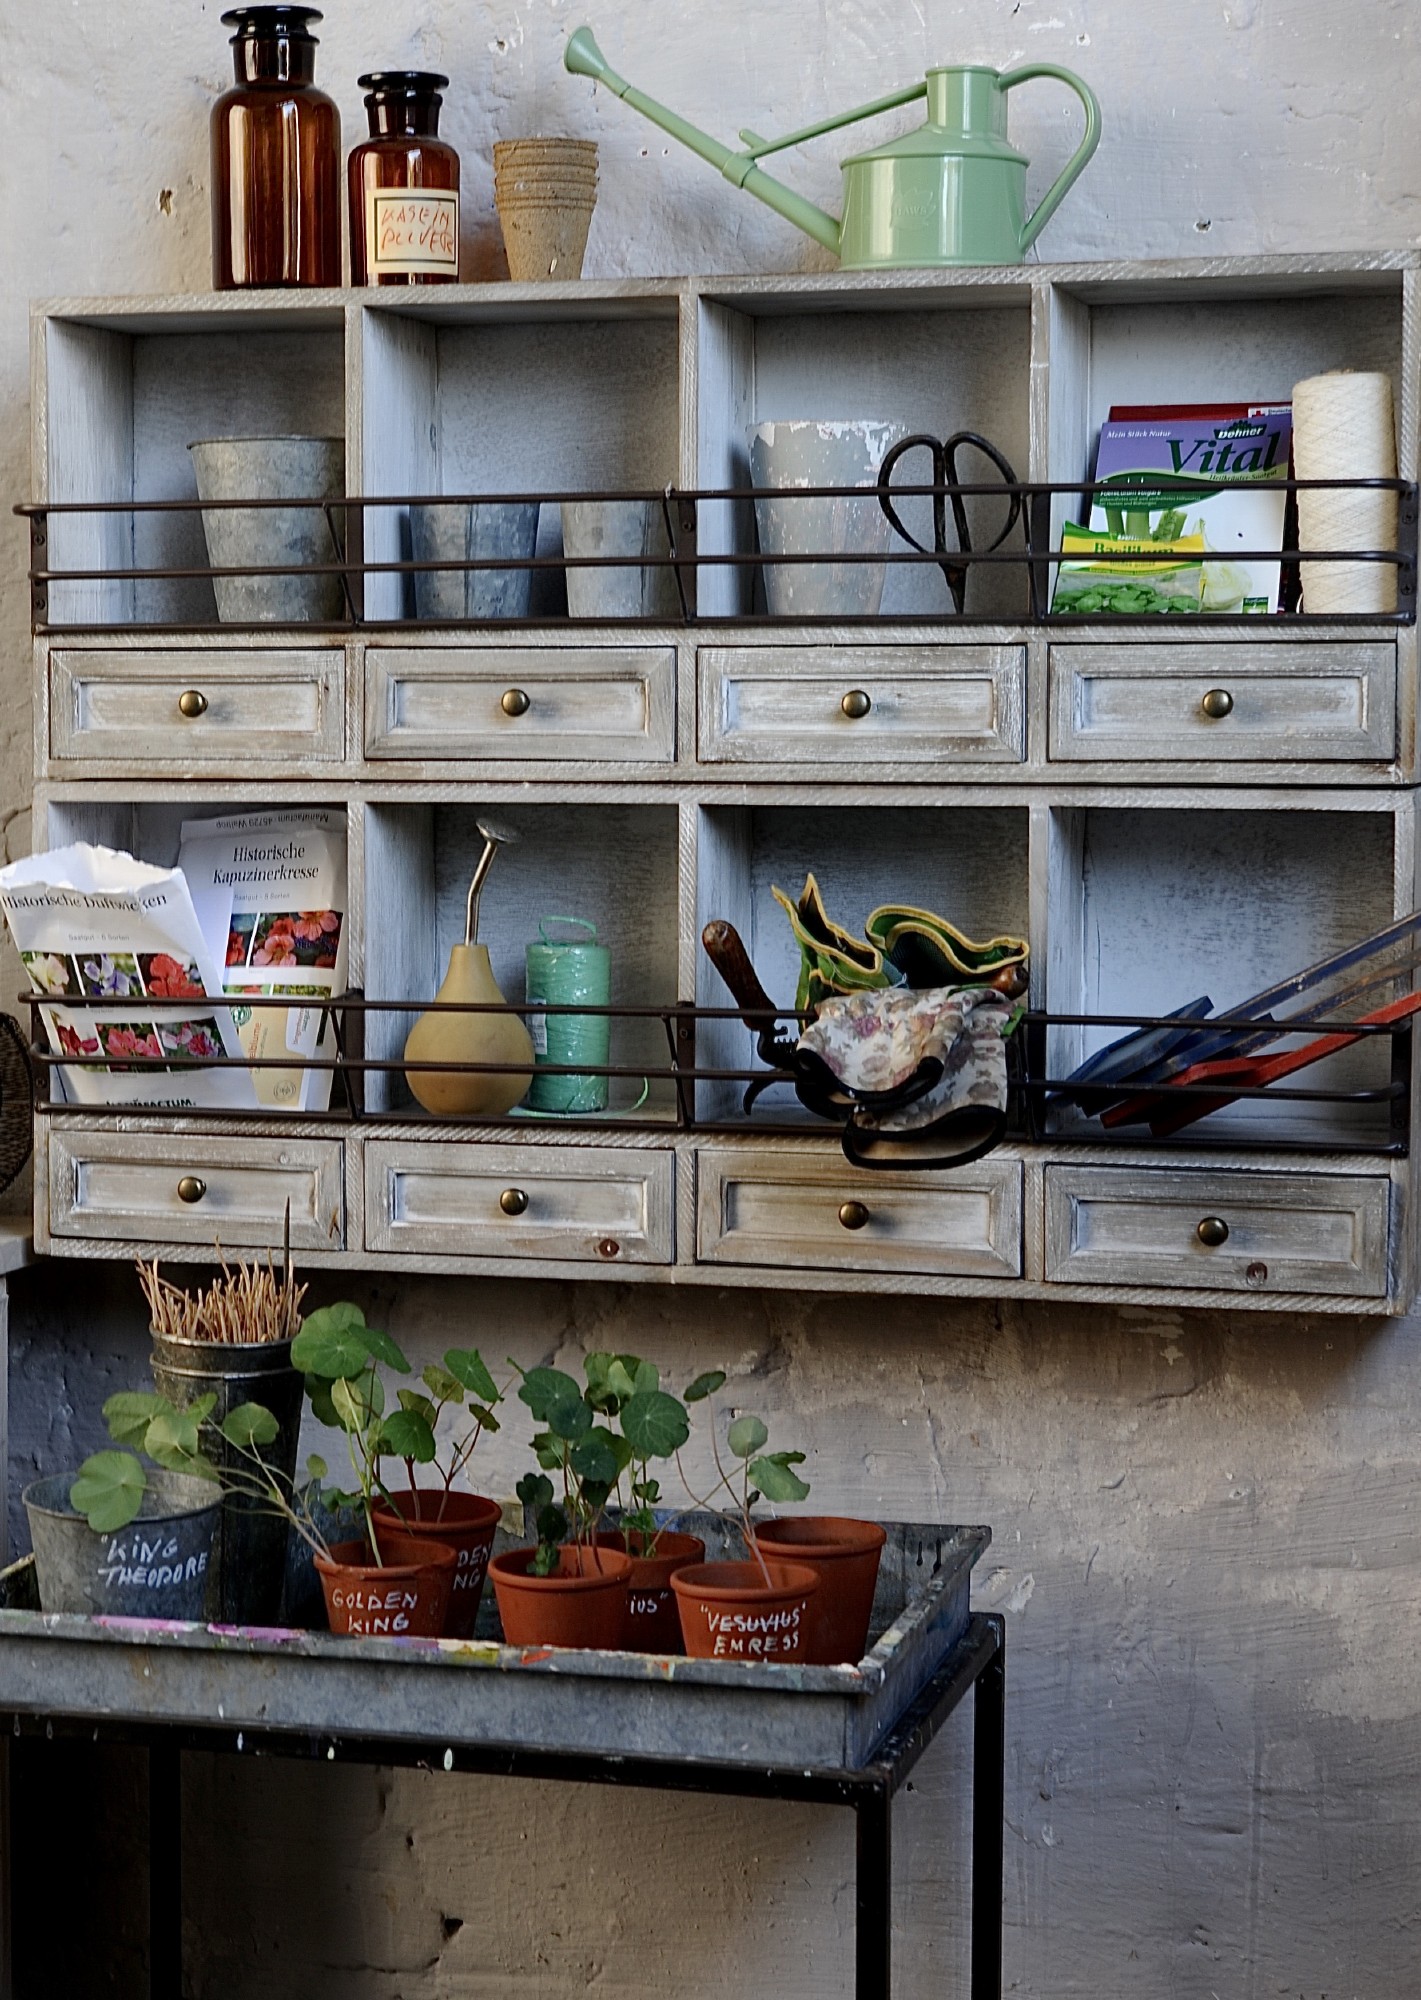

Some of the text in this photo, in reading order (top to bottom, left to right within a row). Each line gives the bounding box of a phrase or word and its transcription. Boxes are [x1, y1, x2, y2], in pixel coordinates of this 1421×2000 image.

[1218, 427, 1263, 439] Dehner
[1166, 431, 1282, 475] Vital
[233, 842, 305, 862] Historische
[213, 864, 319, 887] Kapuzinerkresse
[2, 893, 82, 909] Historische
[98, 1552, 207, 1588] THEODORE
[453, 1569, 480, 1591] NG
[332, 1589, 417, 1612] GOLDEN
[348, 1612, 409, 1633] KING
